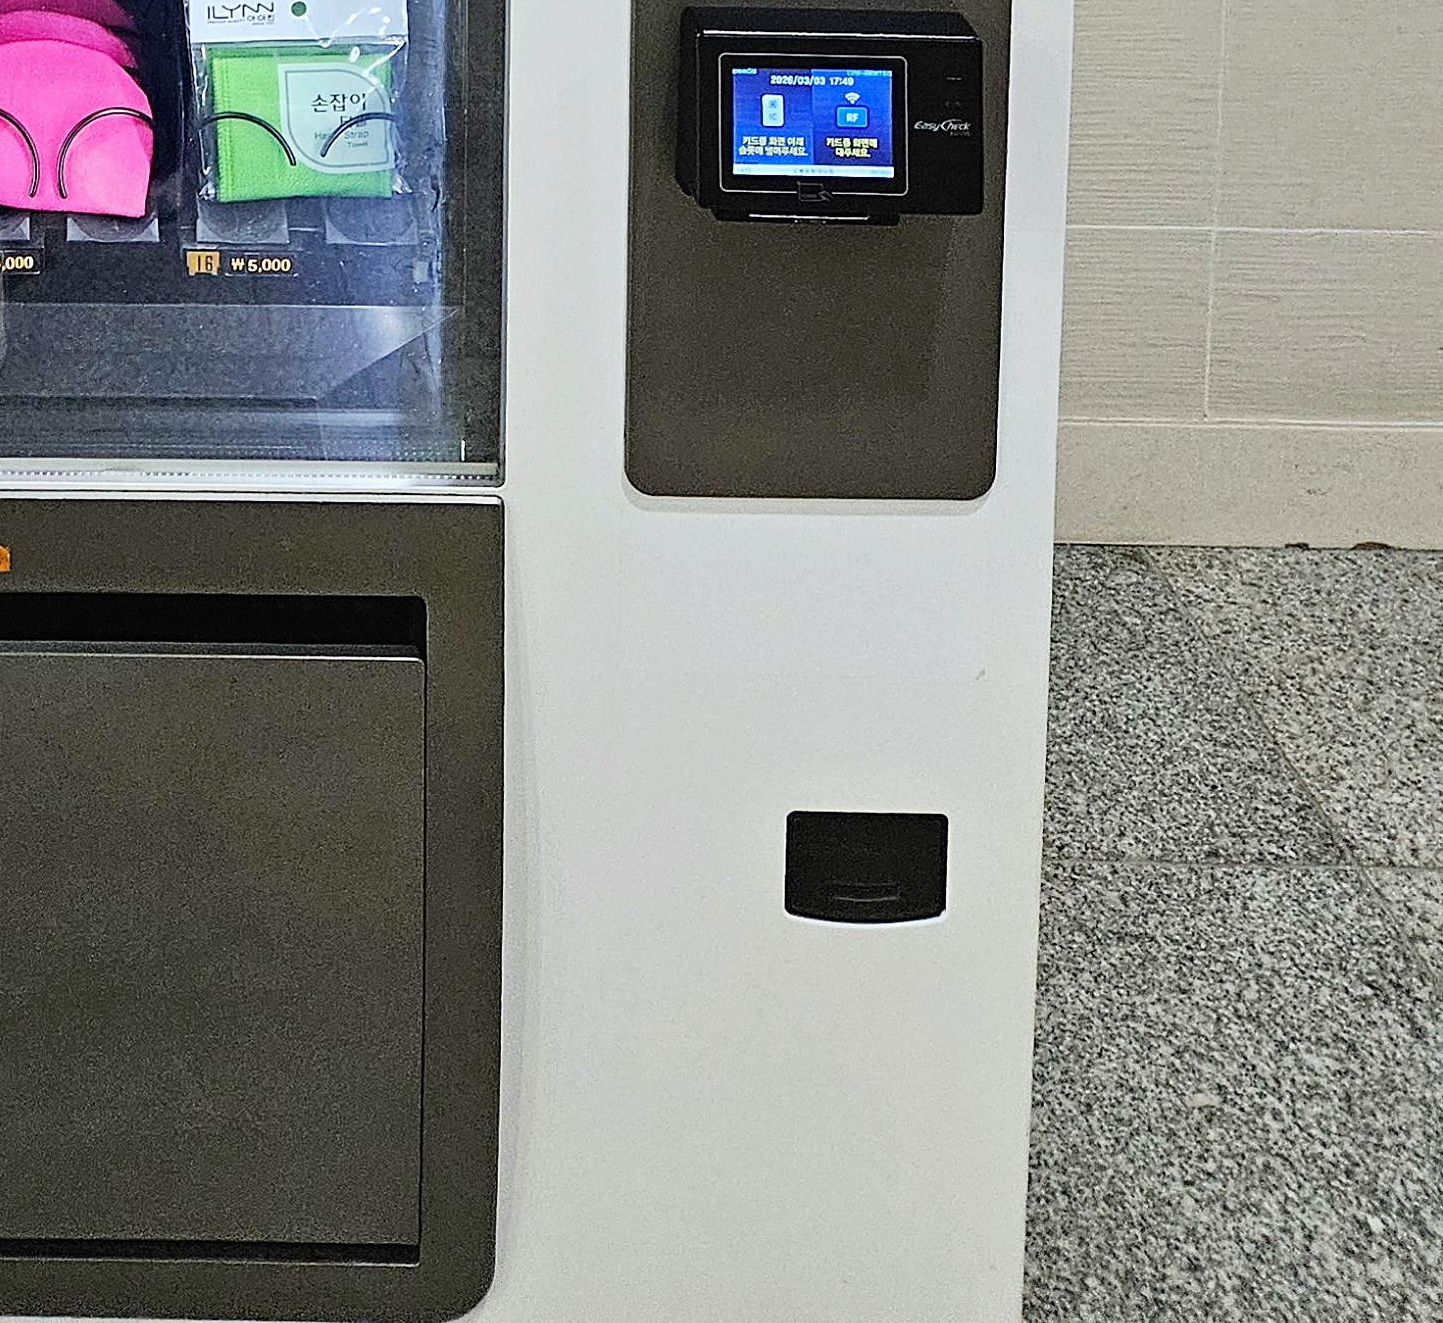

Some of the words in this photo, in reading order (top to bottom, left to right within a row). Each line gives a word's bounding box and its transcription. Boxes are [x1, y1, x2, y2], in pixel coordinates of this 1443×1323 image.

[208, 2, 274, 19] ILYNN
[770, 75, 825, 86] 2026/03/03
[311, 93, 366, 112] 손잡이
[846, 113, 859, 122] RF
[230, 256, 291, 273] ₩5,000
